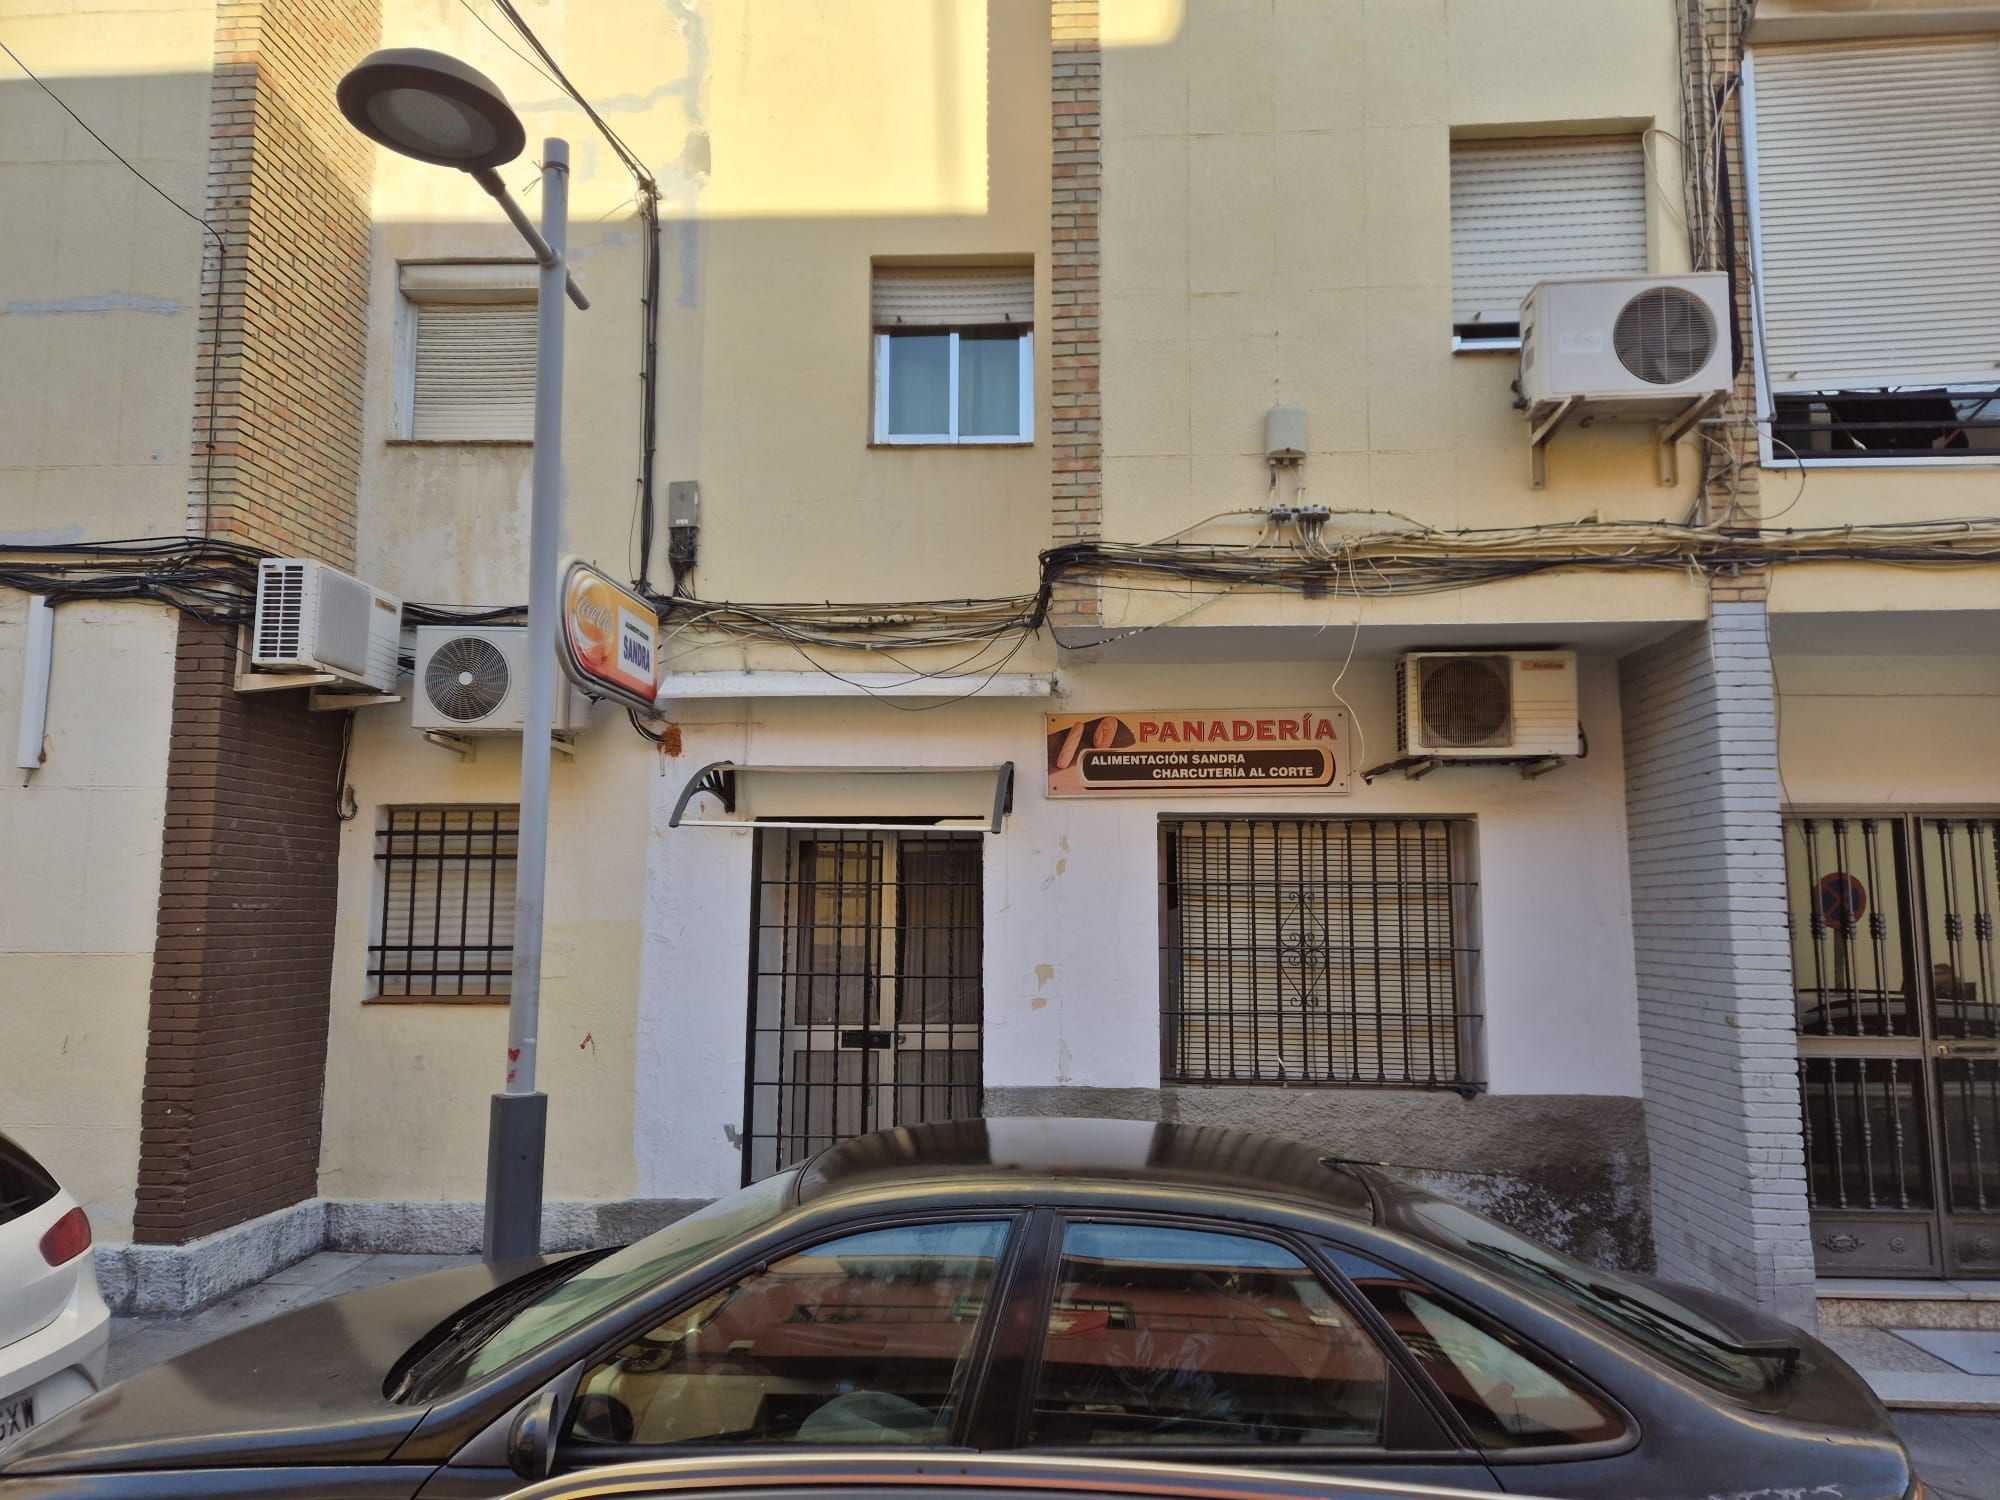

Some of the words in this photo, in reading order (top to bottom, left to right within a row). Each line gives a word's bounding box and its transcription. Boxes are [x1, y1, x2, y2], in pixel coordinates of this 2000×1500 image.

[623, 635, 650, 673] SANDRA
[1138, 713, 1338, 743] PANADERÍA
[1091, 752, 1188, 766] ALIMENTACIÓN
[1191, 753, 1246, 765] SANDRA
[1152, 765, 1246, 779] CHARCUTERÍA
[1249, 767, 1266, 777] AL
[1269, 766, 1314, 777] CORTE
